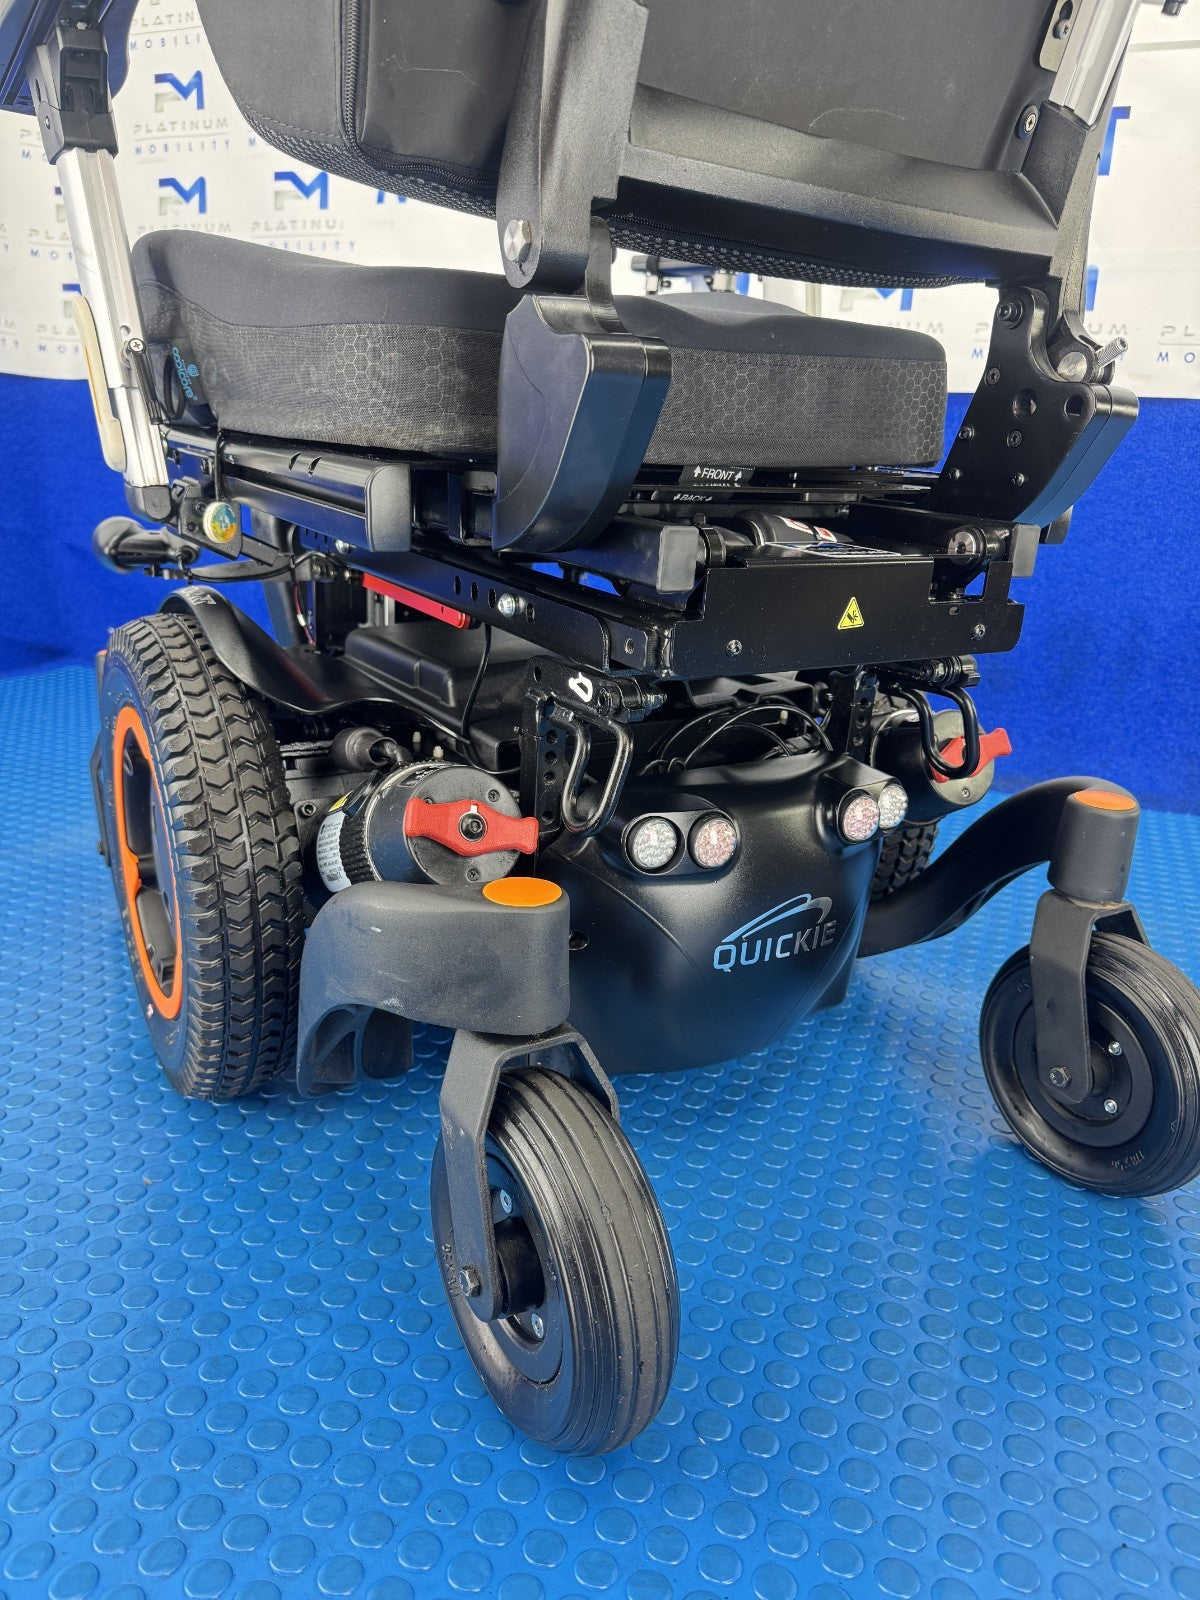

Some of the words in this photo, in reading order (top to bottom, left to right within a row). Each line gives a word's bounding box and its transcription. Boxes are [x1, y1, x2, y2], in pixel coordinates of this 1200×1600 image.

[130, 33, 200, 50] MOBILI
[133, 117, 229, 134] PLATINUM
[134, 139, 231, 155] MOBILITY
[701, 467, 736, 481] FRONT
[679, 494, 706, 502] BACK
[713, 919, 838, 973] QUICKIE
